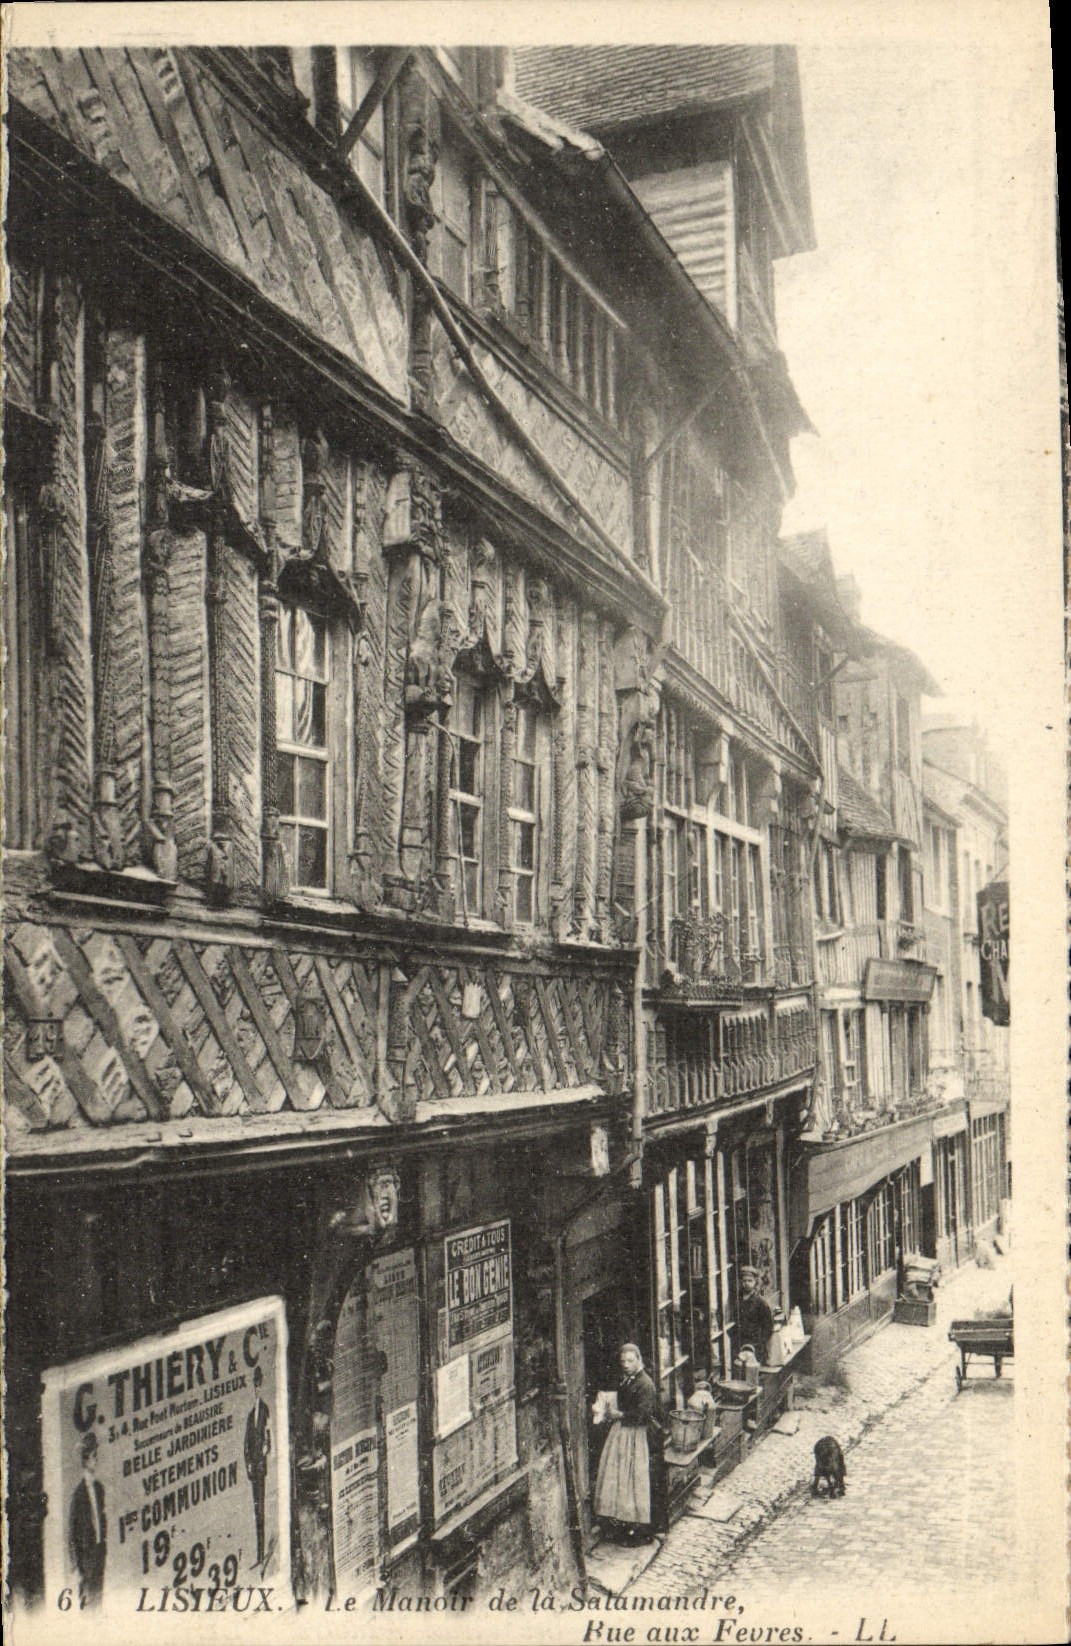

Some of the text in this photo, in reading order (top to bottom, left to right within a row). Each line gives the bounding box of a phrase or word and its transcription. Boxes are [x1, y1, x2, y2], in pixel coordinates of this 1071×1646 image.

[449, 1270, 460, 1308] LE
[463, 1262, 482, 1304] BON
[228, 1350, 237, 1374] &
[204, 1375, 247, 1402] LISIEUX
[123, 1446, 162, 1478] BELLE
[141, 1461, 238, 1532] COMMUNION
